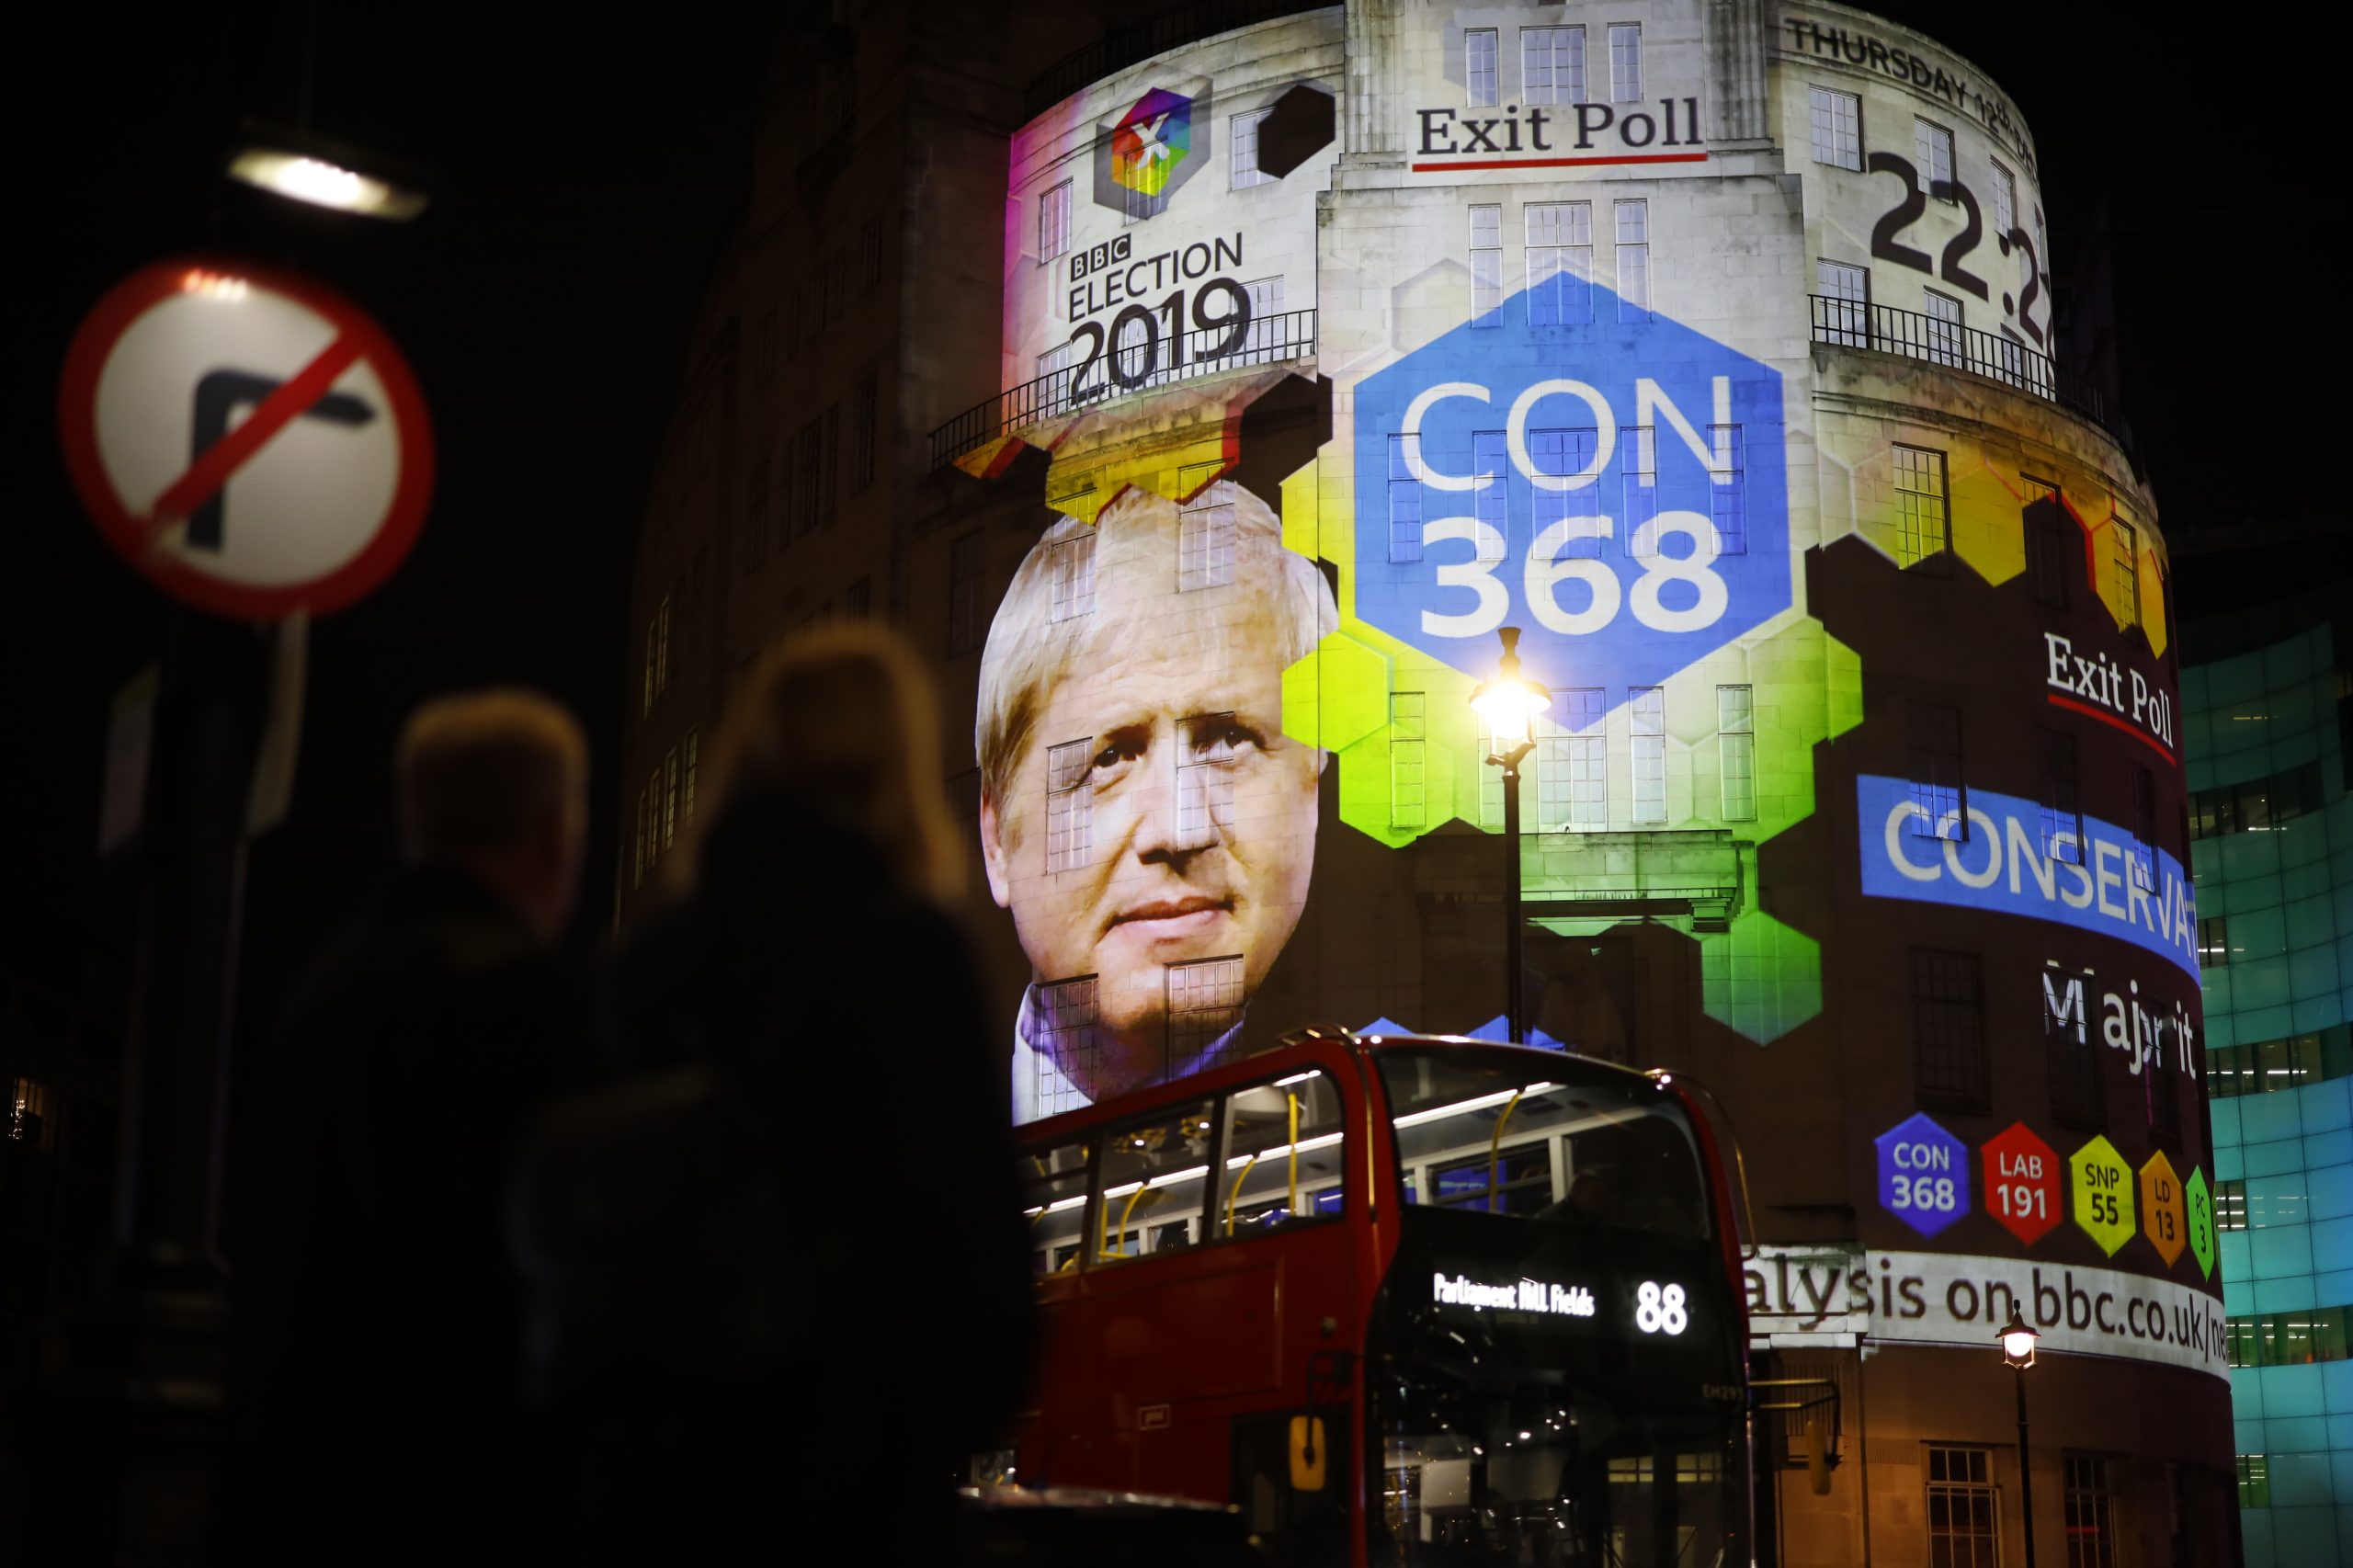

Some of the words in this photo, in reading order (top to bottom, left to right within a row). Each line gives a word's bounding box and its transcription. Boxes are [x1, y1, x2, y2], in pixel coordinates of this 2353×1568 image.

[1785, 18, 1966, 108] THURSDAY
[1416, 105, 1552, 155] Exit
[1573, 97, 1703, 149] Poll
[1069, 232, 1242, 324] ELECTION
[1072, 233, 1131, 281] BBC
[1069, 278, 1253, 407] 2019
[1401, 375, 1734, 492] CON
[1421, 510, 1729, 638] 368
[2044, 631, 2125, 713] Exit
[2130, 667, 2174, 749] Poll
[1893, 1142, 1949, 1170] CON
[1999, 1152, 2043, 1180] LAB
[2086, 1163, 2120, 1190] SNP
[1891, 1176, 1956, 1211] 368
[1997, 1184, 2046, 1220] 191
[2090, 1193, 2120, 1226] 55
[2154, 1176, 2170, 1203] LD
[2195, 1193, 2206, 1219] PC
[2155, 1209, 2176, 1242] 13
[2200, 1223, 2207, 1254] 3
[1433, 1272, 1517, 1310] Parliament
[1518, 1280, 1550, 1313] Hill
[1550, 1283, 1596, 1317] Fields
[1636, 1279, 1688, 1335] 88
[1946, 1278, 2014, 1324] on
[2031, 1267, 2228, 1364] bbc.co.uk/ne
